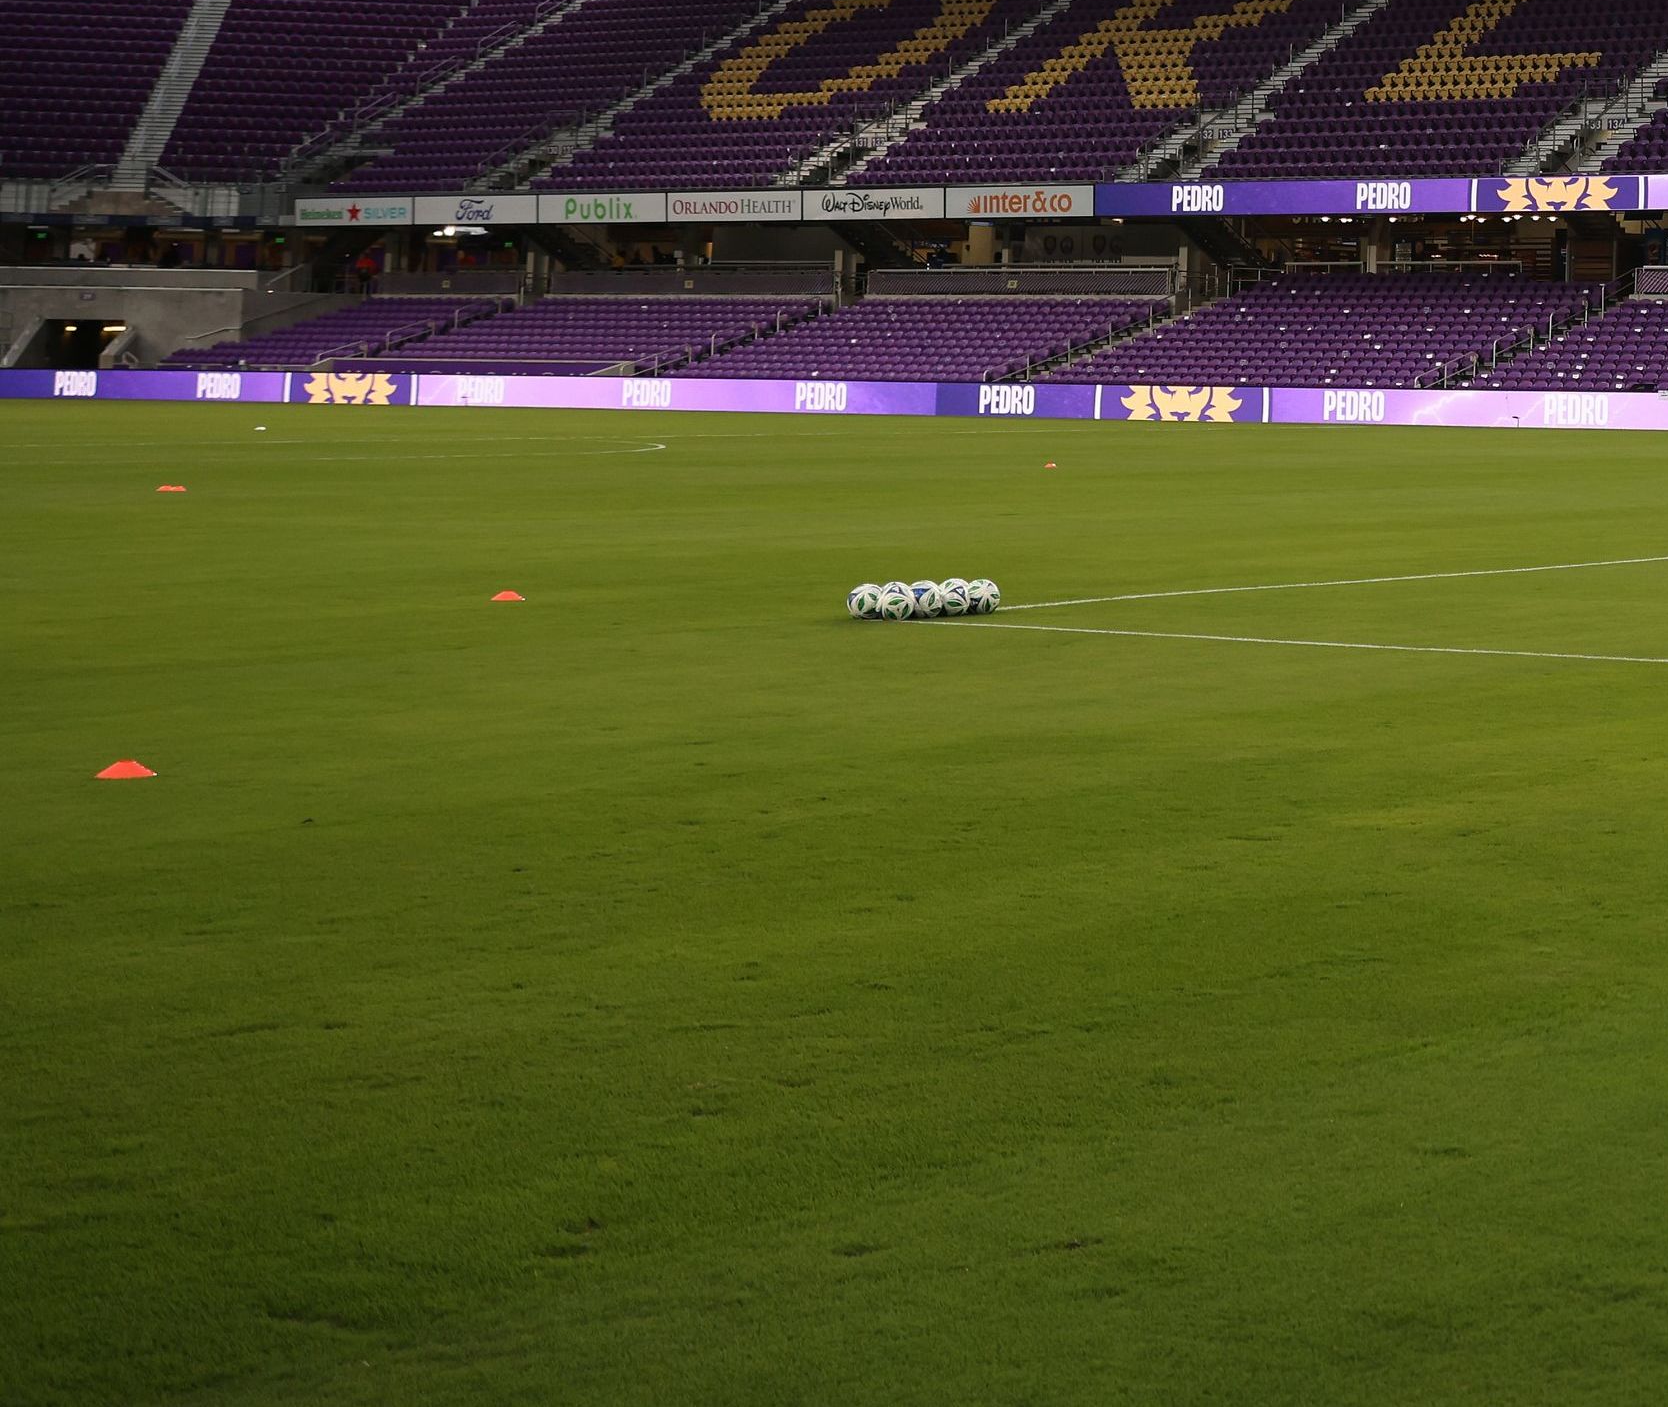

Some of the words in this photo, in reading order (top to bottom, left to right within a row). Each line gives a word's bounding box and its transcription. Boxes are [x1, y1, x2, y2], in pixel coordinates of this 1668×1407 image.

[564, 196, 633, 220] Publix
[672, 199, 738, 215] ORLANDO
[740, 198, 792, 214] HEALTH
[889, 195, 921, 210] World
[983, 191, 1072, 213] inter&co
[1171, 185, 1224, 212] PEDRO
[1356, 181, 1410, 210] PEDRO
[363, 206, 407, 219] SILVER
[455, 198, 495, 221] Ford
[54, 371, 97, 397] PEDRO
[196, 373, 242, 399] PEDRO
[456, 376, 505, 405] PEDRO
[622, 379, 672, 408] PEDRO
[795, 381, 848, 412] PEDRO
[979, 384, 1035, 415] PEDRO
[1323, 390, 1385, 422] PEDRO
[1544, 392, 1609, 426] PEDRO
